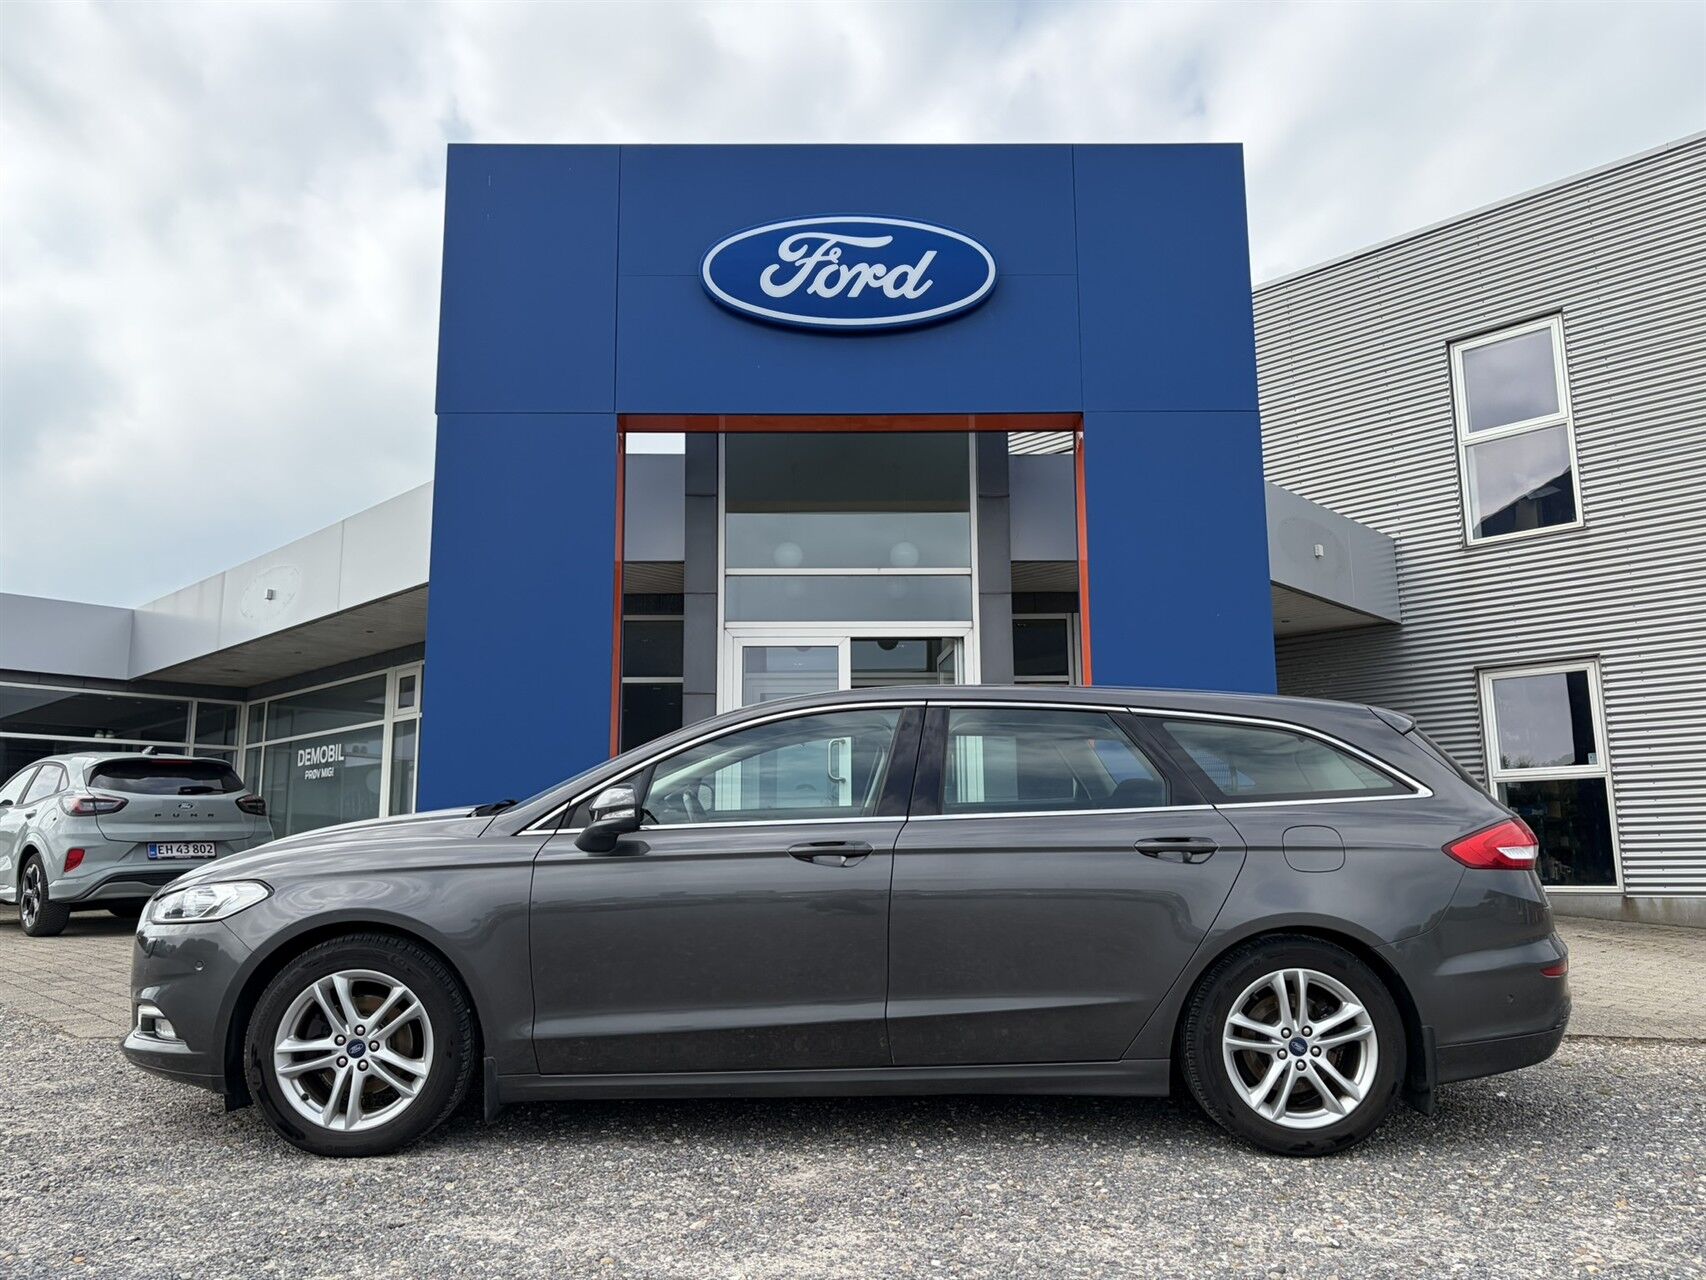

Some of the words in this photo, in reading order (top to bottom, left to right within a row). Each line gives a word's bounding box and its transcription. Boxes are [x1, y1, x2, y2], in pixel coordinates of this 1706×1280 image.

[759, 231, 938, 299] Ford
[297, 743, 345, 767] DEMOBIL
[157, 844, 174, 855] EH
[176, 844, 190, 854] 43
[192, 844, 213, 854] 802
